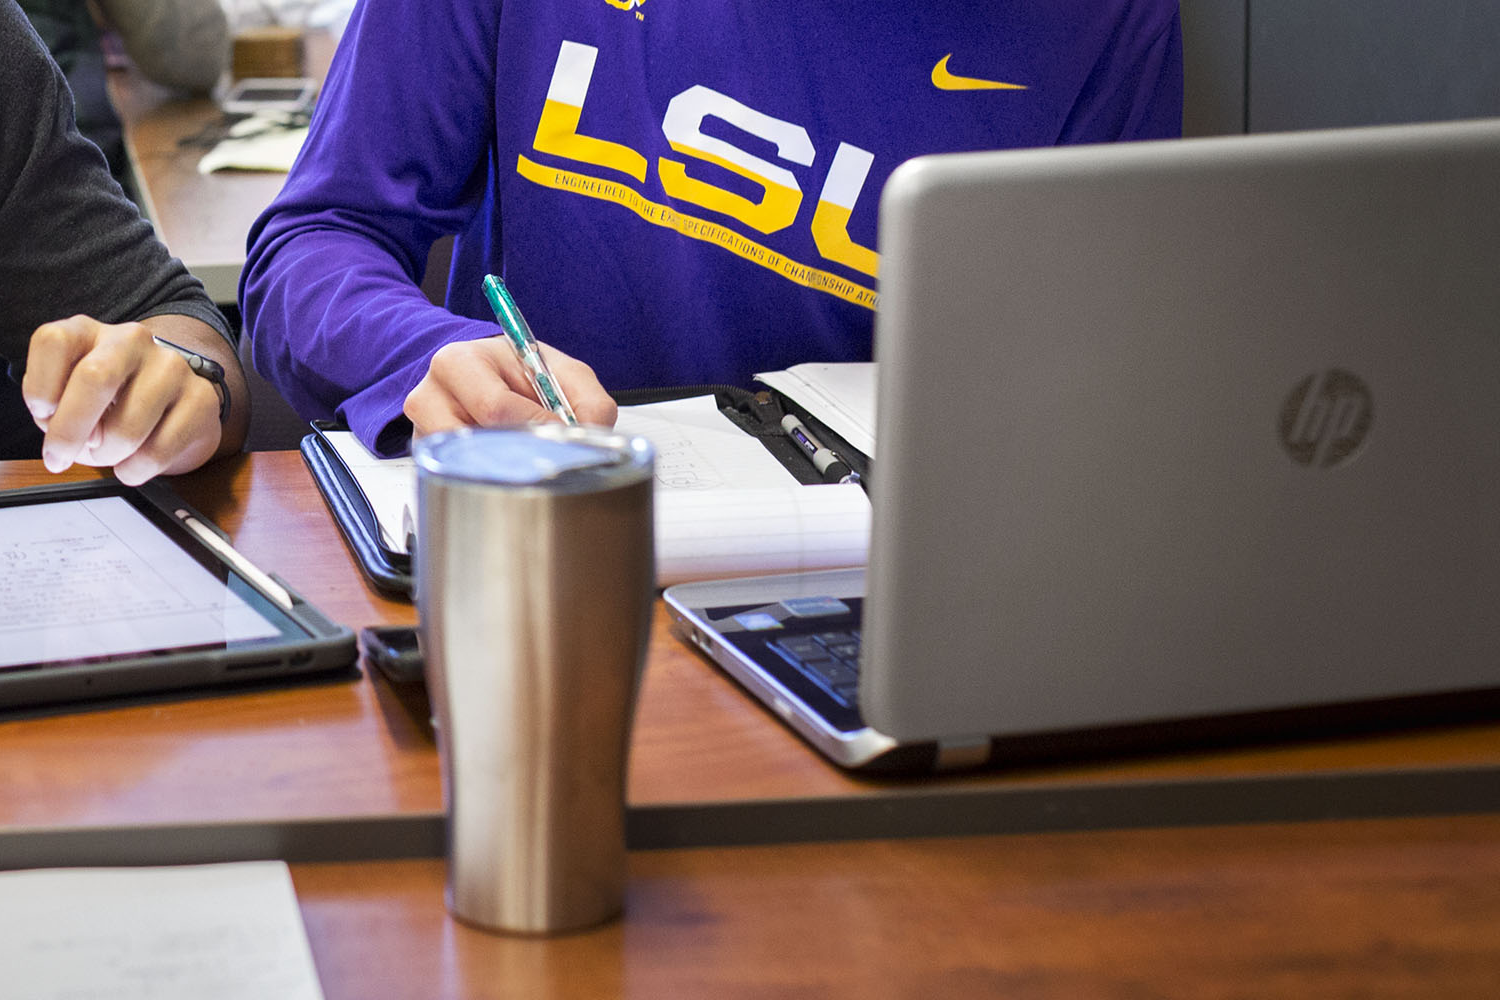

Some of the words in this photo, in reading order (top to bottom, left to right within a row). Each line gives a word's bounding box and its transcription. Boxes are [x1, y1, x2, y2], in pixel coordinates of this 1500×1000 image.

[554, 173, 626, 200] ENGINEERED
[640, 200, 655, 218] THE
[684, 218, 765, 261] SPECIFICATIONS
[767, 254, 781, 267] OF
[783, 262, 855, 296] CHAMONSHIP
[1286, 371, 1364, 467] hp
